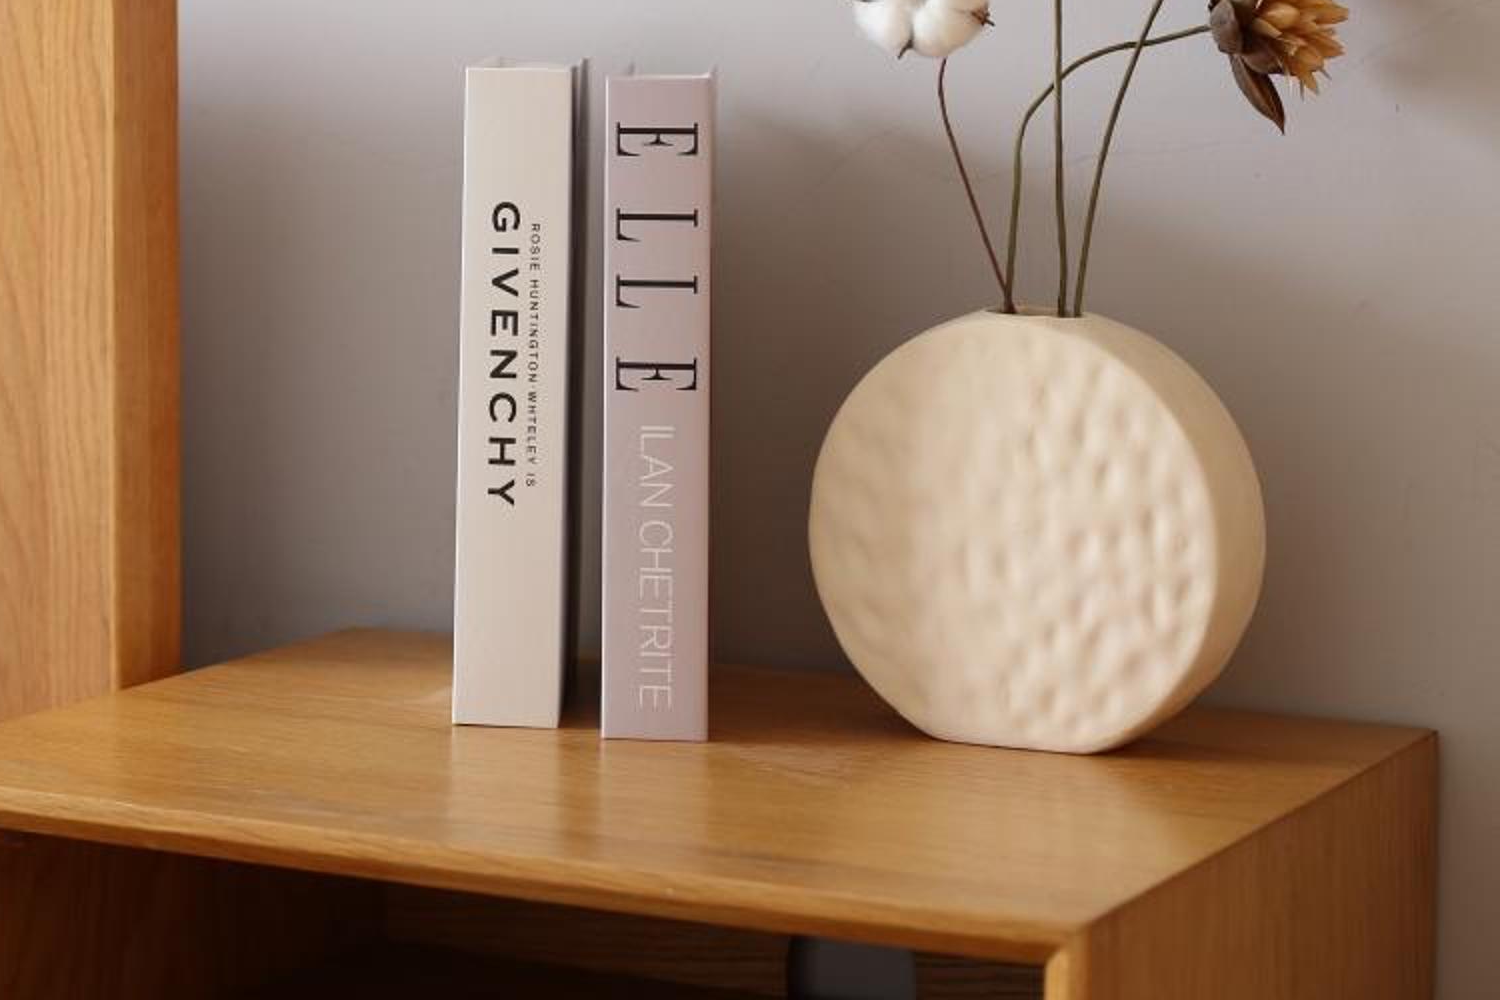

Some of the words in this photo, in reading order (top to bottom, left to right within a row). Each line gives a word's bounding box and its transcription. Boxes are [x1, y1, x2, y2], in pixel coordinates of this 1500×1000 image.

[528, 223, 541, 271] ROSIE
[615, 121, 699, 392] ELLE
[487, 201, 521, 505] GIVENCHY
[525, 473, 536, 487] IS
[639, 425, 676, 507] ILAN
[638, 519, 674, 709] CHETRITE
